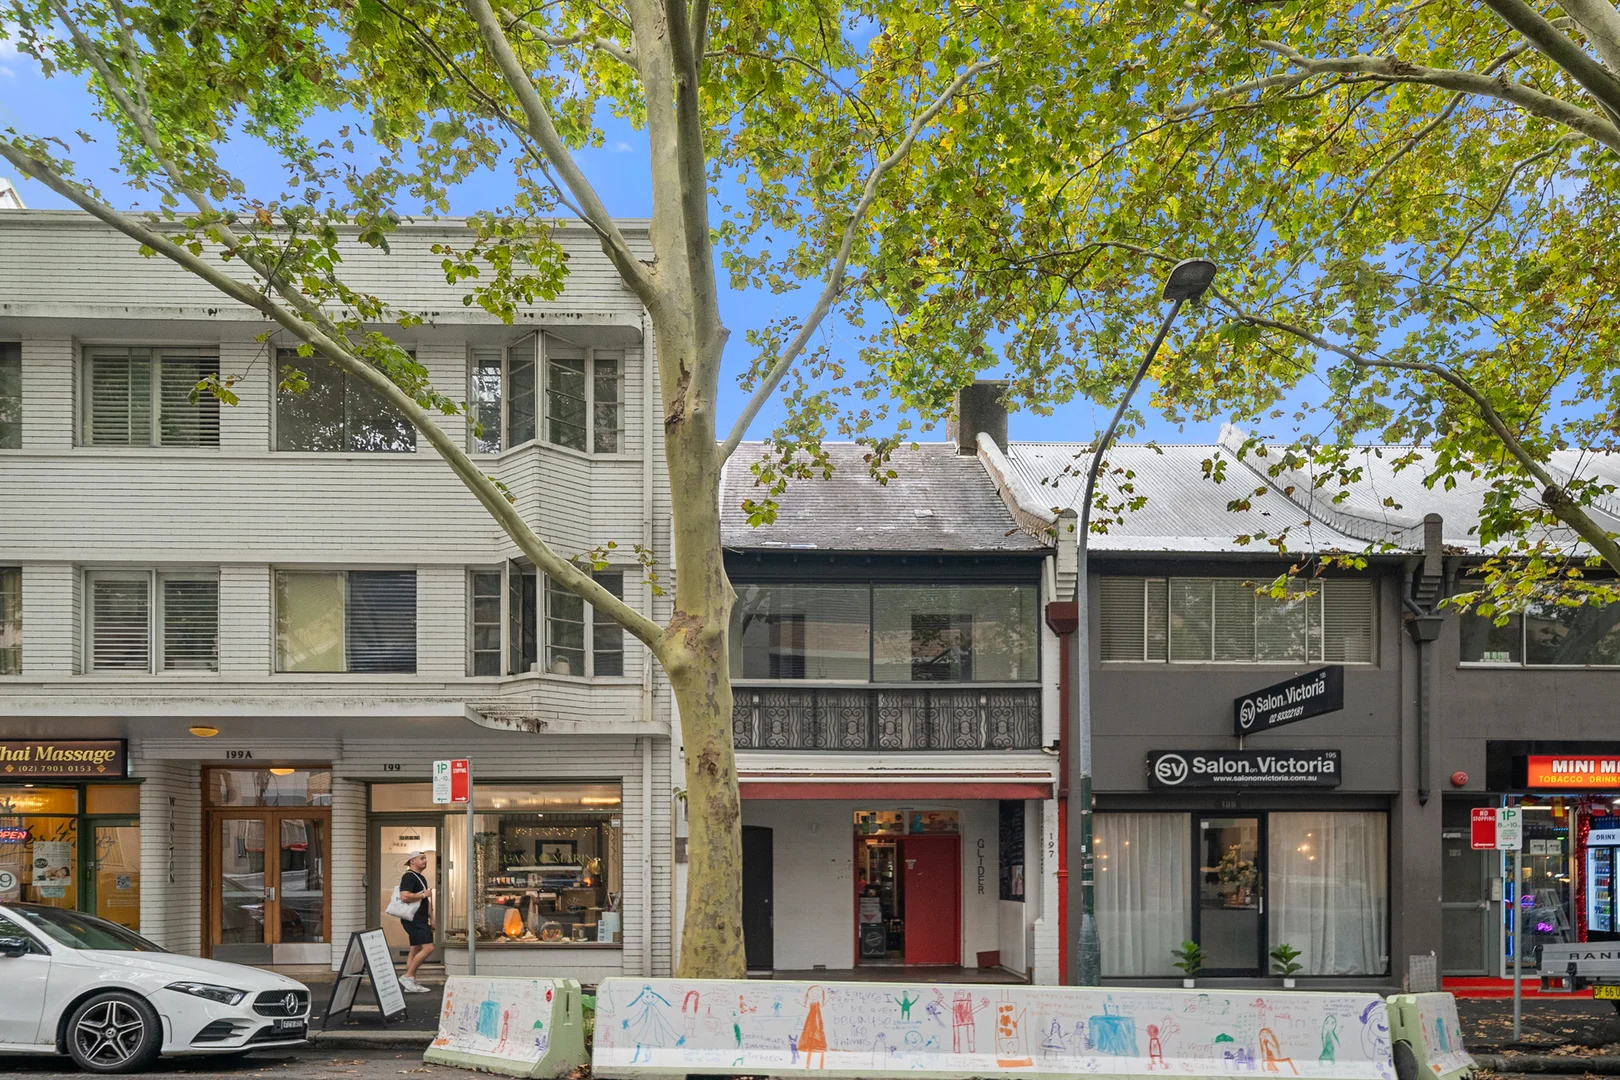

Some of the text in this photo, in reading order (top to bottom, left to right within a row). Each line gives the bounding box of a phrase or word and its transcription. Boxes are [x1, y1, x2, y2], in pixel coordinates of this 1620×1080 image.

[1256, 694, 1284, 713] Salon
[1285, 678, 1325, 704] Victoria
[1269, 713, 1278, 724] 02
[35, 746, 116, 765] Massage
[226, 750, 252, 759] 199A
[383, 764, 400, 772] 199
[437, 762, 448, 774] 1P
[1192, 757, 1250, 774] Salon
[1257, 757, 1335, 774] Victoria
[1552, 760, 1620, 773] MINI M
[1538, 775, 1583, 783] TOBACCO
[1502, 809, 1516, 821] 1P
[977, 838, 985, 895] GLIDER
